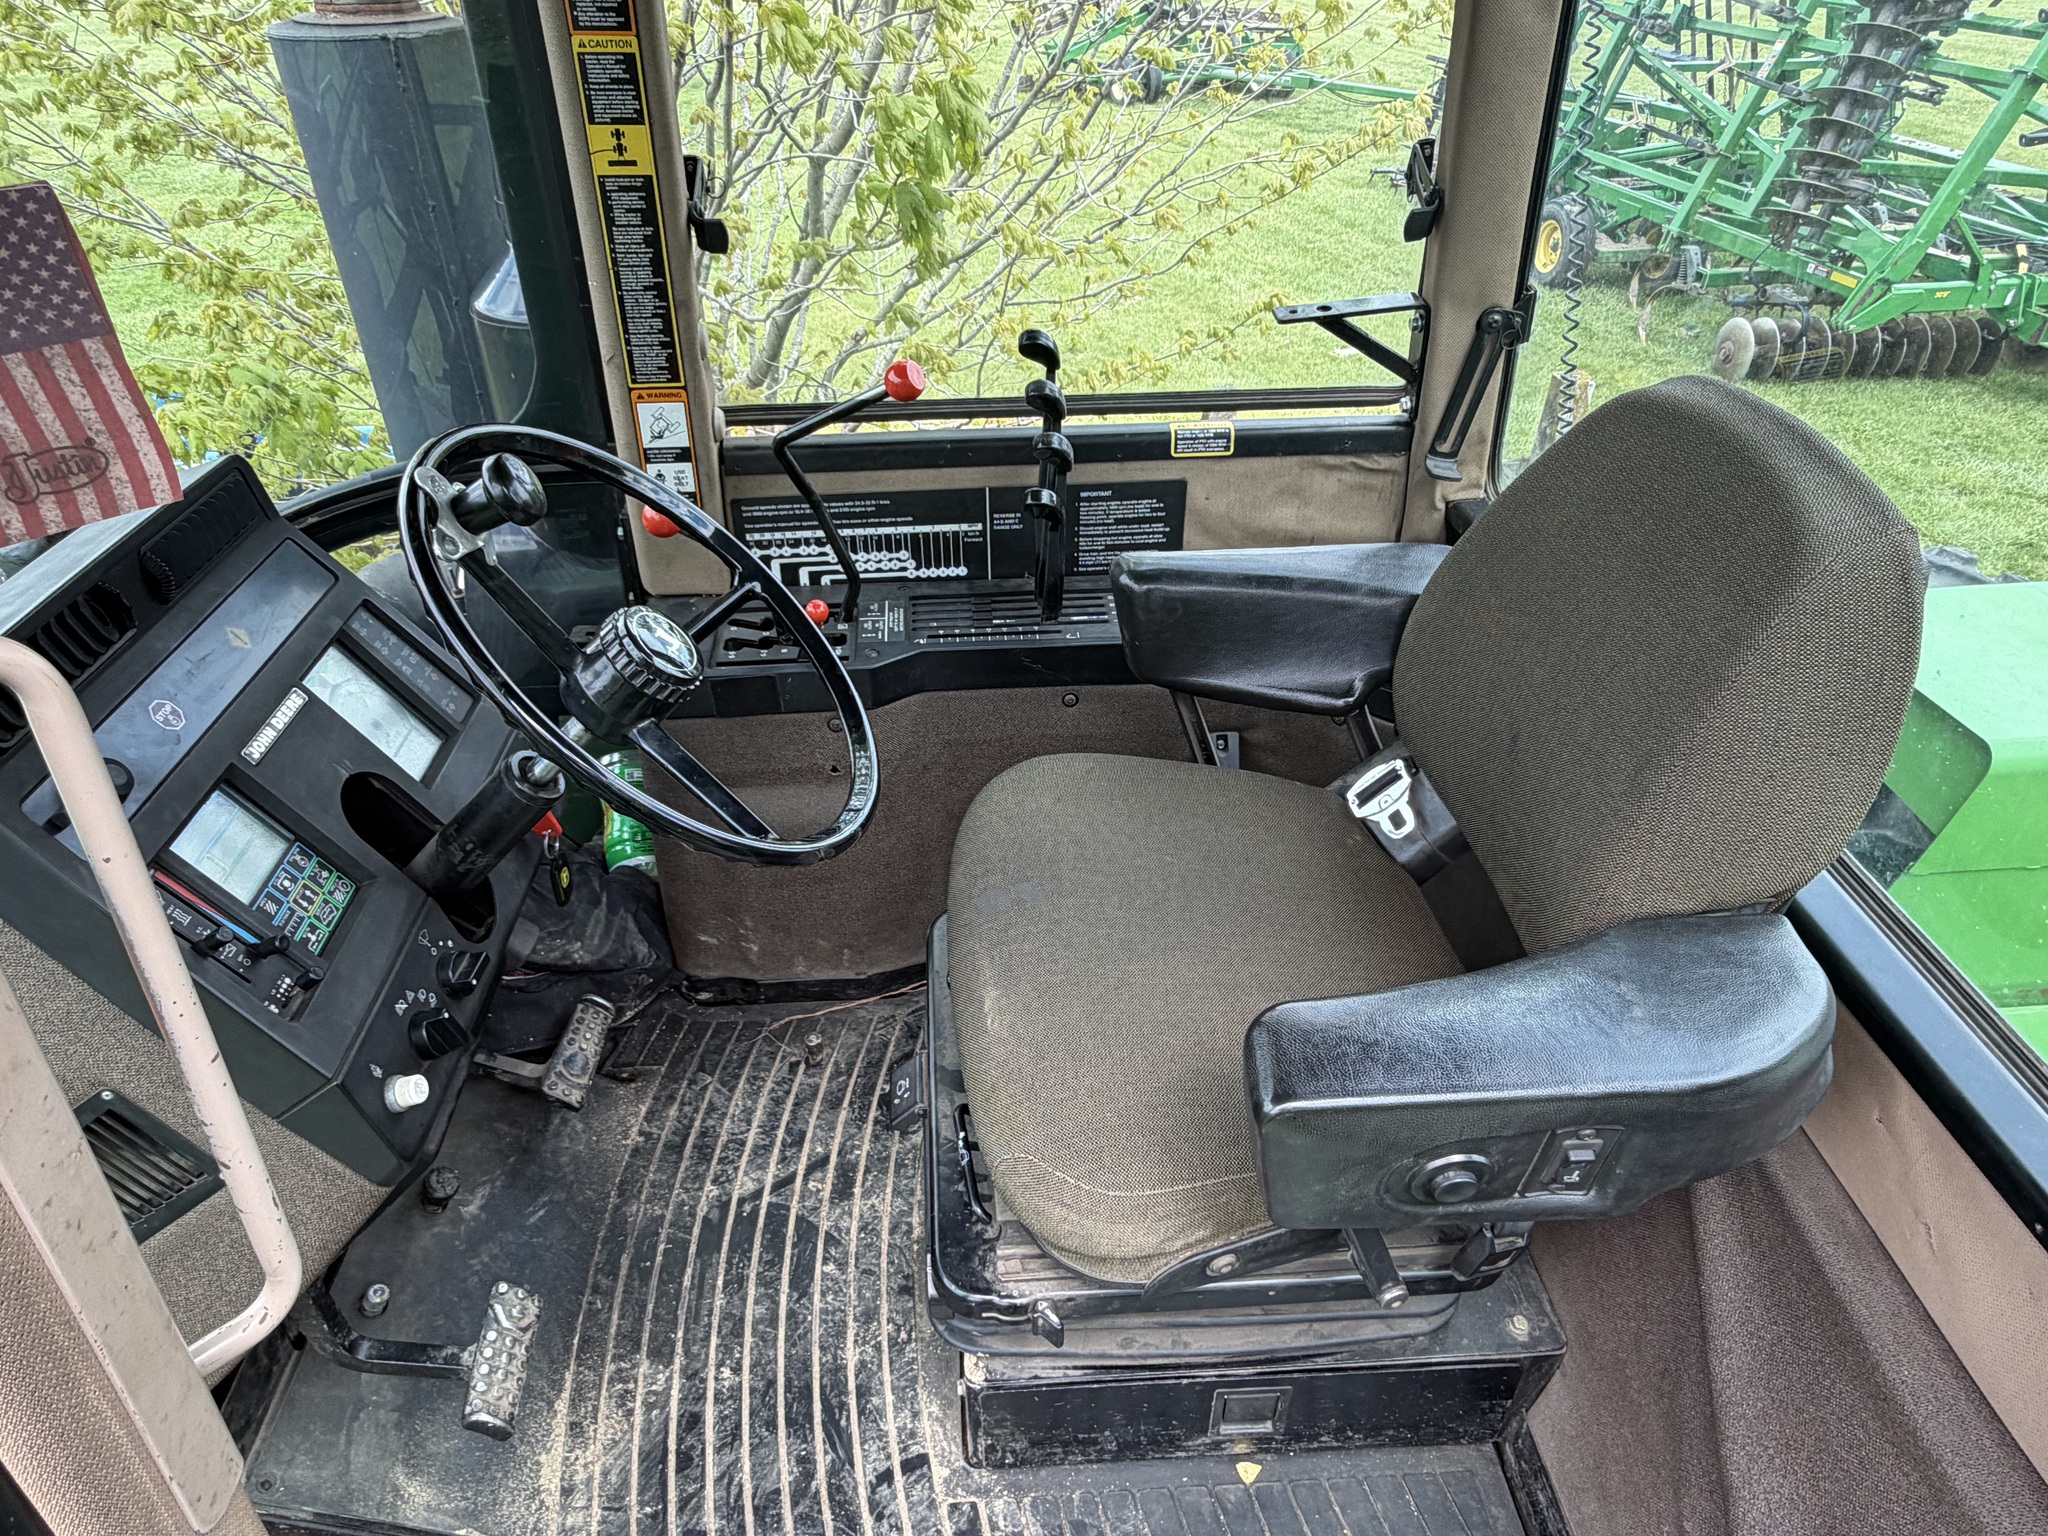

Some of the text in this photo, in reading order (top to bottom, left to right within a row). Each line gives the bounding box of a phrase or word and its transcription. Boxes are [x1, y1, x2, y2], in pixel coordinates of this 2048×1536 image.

[588, 39, 633, 49] CAUTION
[2, 452, 103, 505] Justin
[155, 704, 172, 722] STOP
[248, 693, 304, 759] JOHN DEERE
